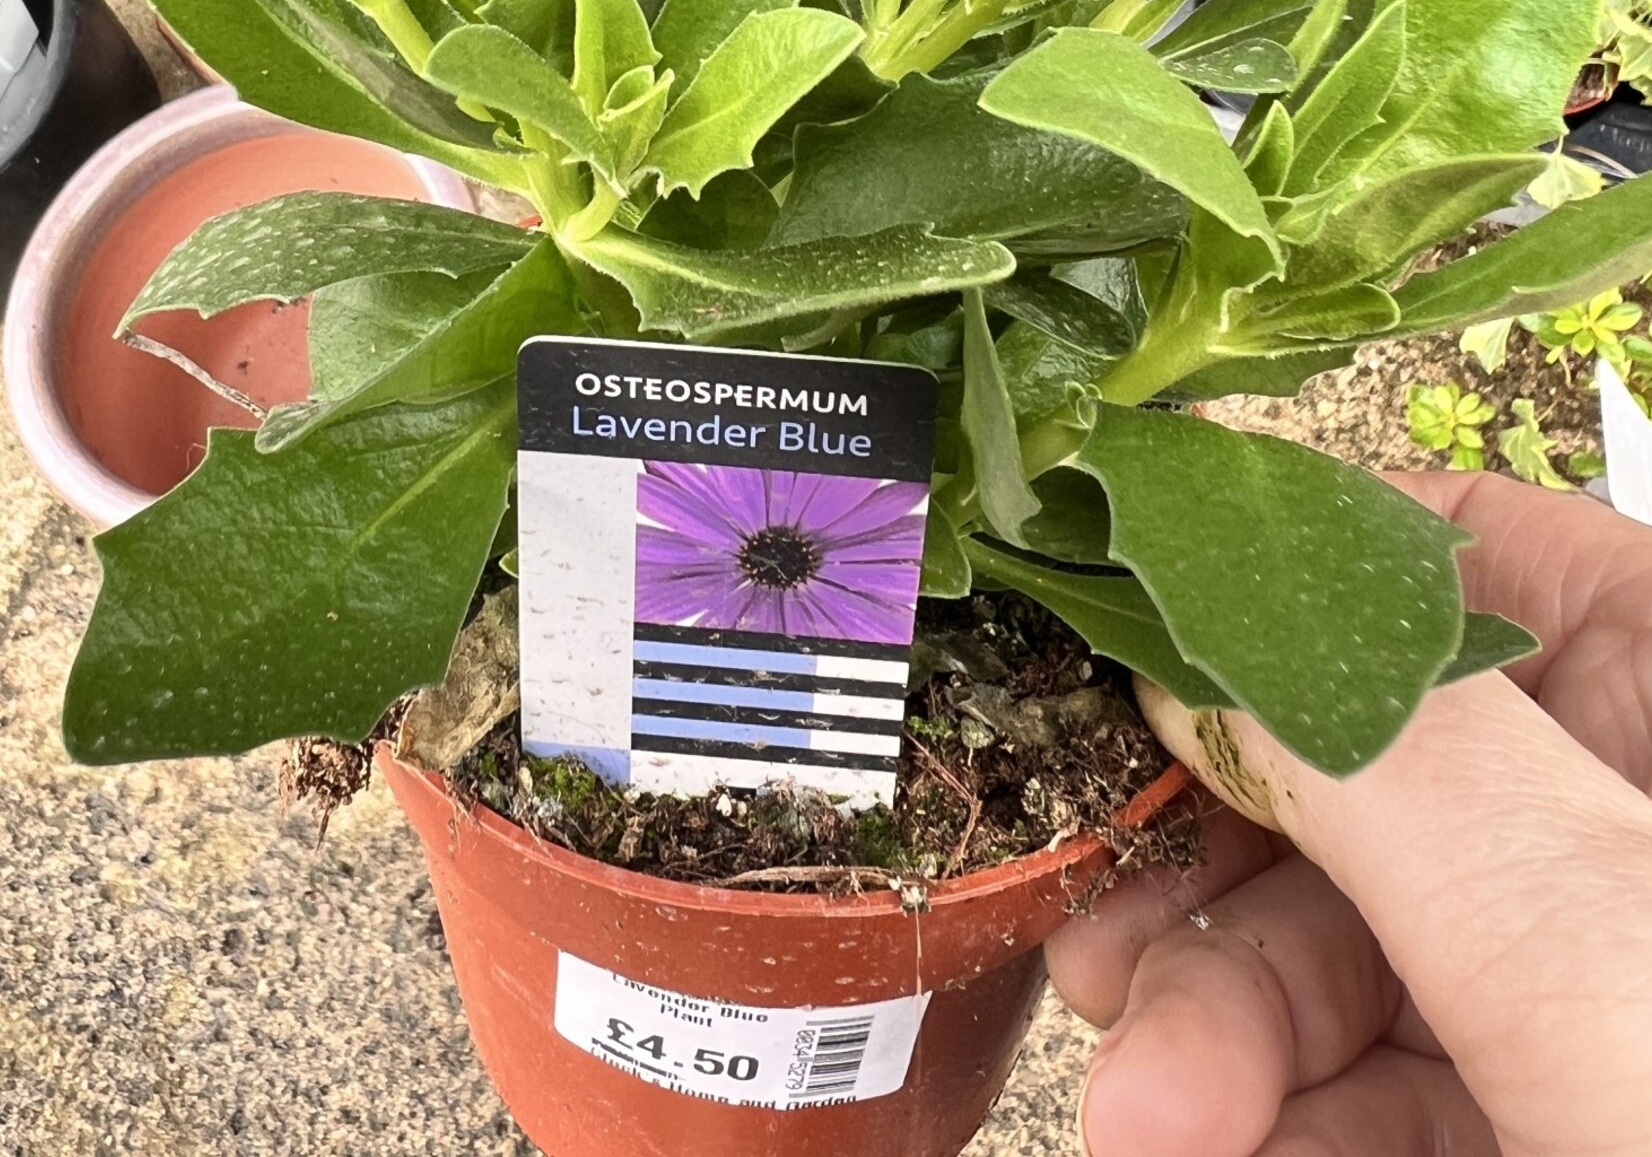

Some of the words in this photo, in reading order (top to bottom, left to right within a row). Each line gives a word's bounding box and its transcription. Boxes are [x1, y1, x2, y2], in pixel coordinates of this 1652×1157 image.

[575, 373, 868, 416] OSTEOSPERMUM
[572, 405, 766, 448] Lavender
[779, 421, 872, 457] Blue
[660, 1003, 712, 1028] Plant
[606, 1017, 759, 1081] £4.50
